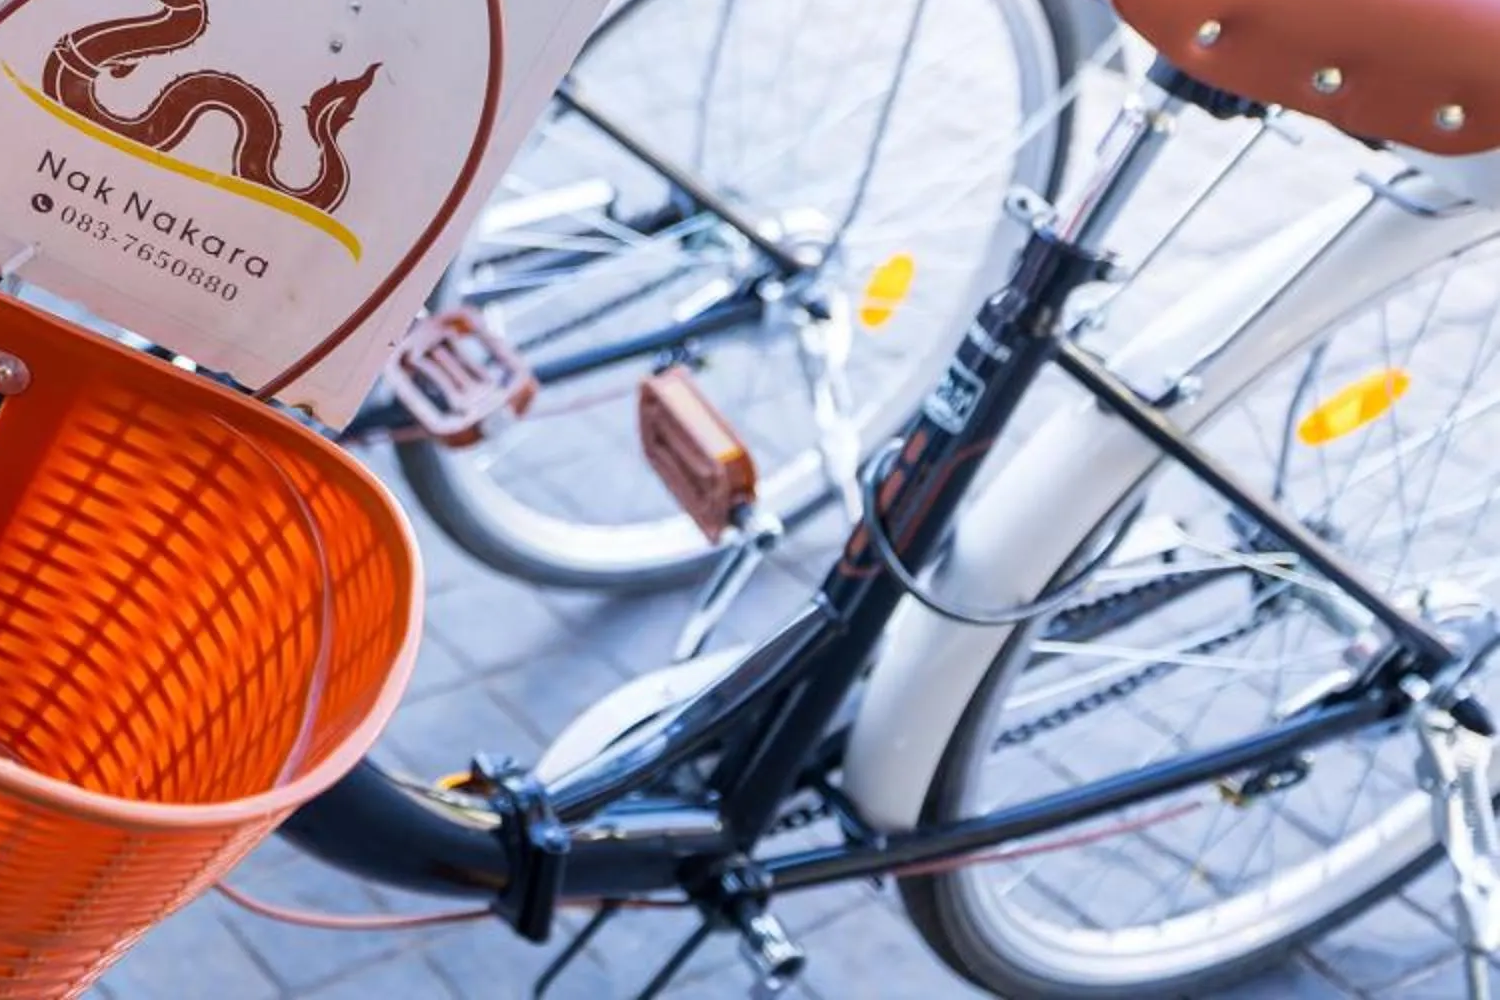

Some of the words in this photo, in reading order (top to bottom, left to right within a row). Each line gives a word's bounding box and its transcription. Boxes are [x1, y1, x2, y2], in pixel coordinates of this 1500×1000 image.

[37, 150, 116, 205] Nak
[123, 191, 269, 279] Nakara
[60, 205, 238, 301] 083-7650880
